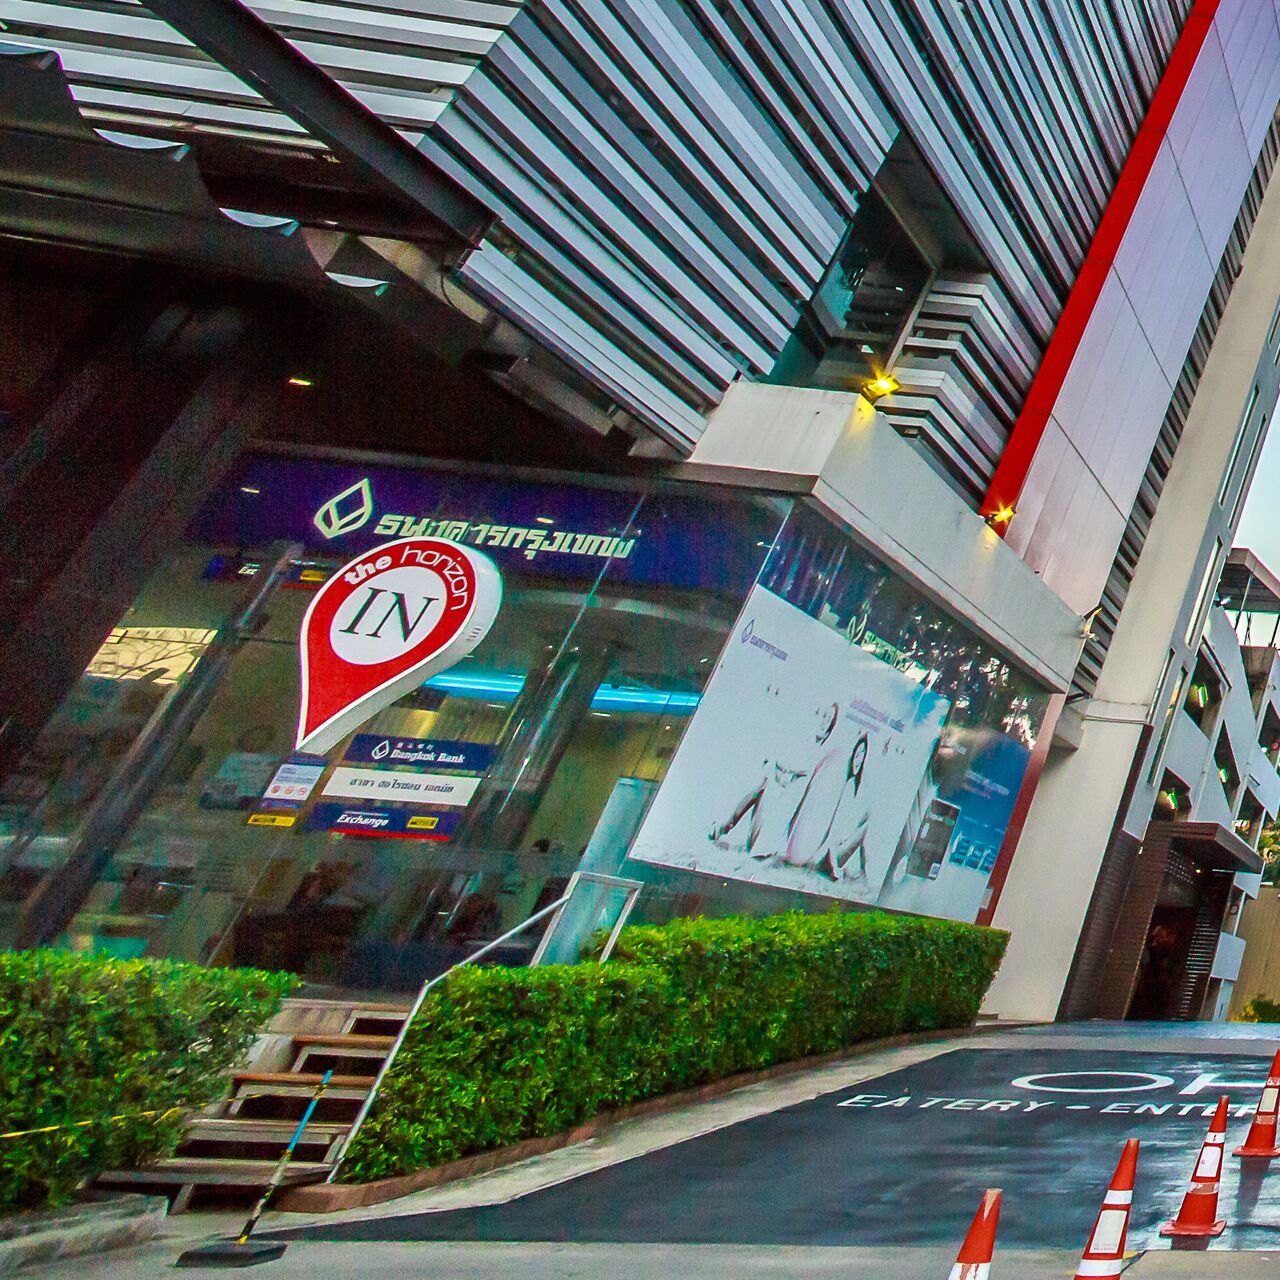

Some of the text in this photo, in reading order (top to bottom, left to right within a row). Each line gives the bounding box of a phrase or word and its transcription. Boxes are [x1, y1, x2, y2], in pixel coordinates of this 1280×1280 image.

[344, 545, 469, 612] the horizon
[338, 586, 440, 643] IN
[390, 748, 466, 764] Bangkok Bank
[336, 813, 389, 827] Exchange
[836, 1094, 1056, 1113] EATERY
